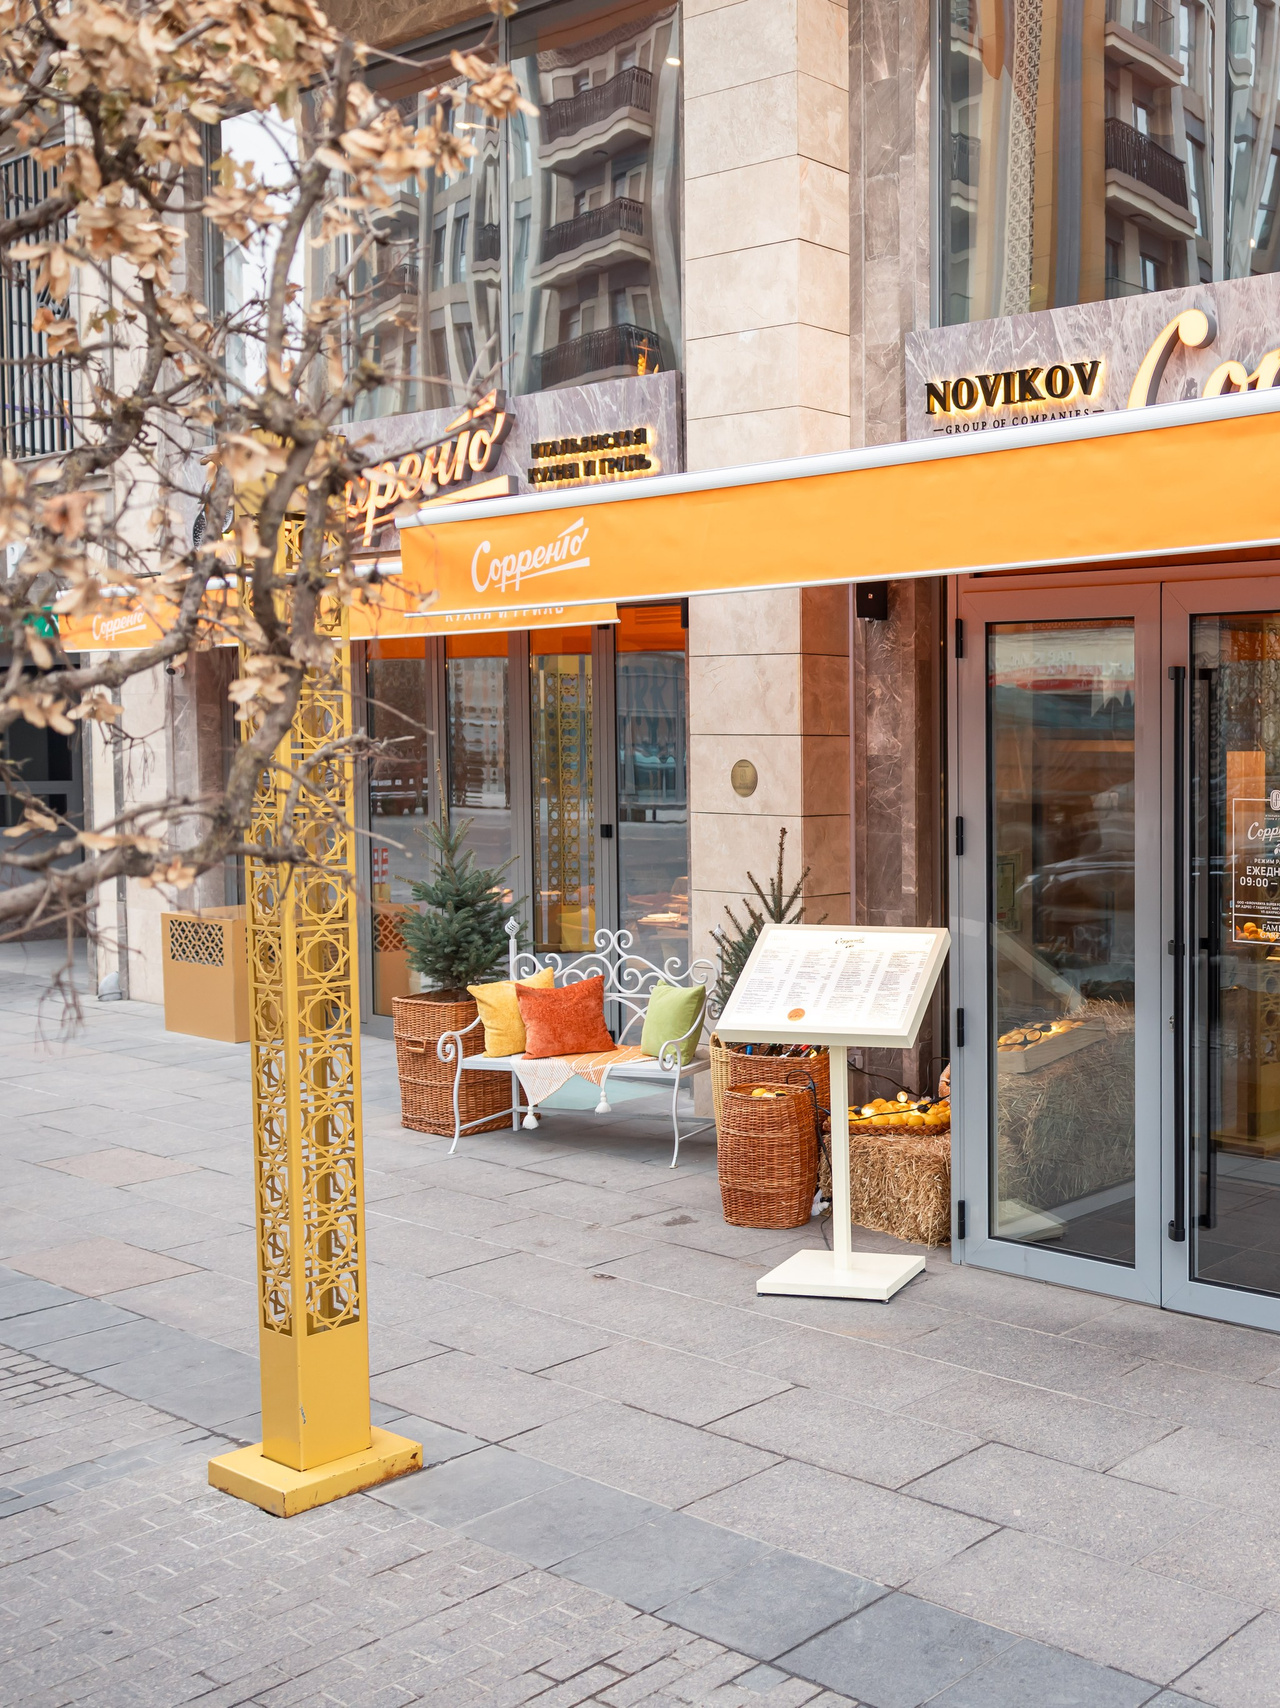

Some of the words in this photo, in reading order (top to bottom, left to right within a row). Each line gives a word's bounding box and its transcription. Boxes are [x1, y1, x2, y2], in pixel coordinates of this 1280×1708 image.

[925, 361, 1101, 415] NOVIKOV
[945, 422, 987, 435] GROUP
[992, 418, 1006, 429] OF
[1012, 408, 1089, 427] COMPANIES
[531, 427, 647, 459] ИТАЛЬЯНСКАЯ
[528, 463, 580, 484] КУХНЯ
[583, 460, 596, 476] И
[599, 454, 652, 475] ГРИЛЬ
[471, 516, 590, 593] Сорренто
[1239, 876, 1269, 888] 09:00
